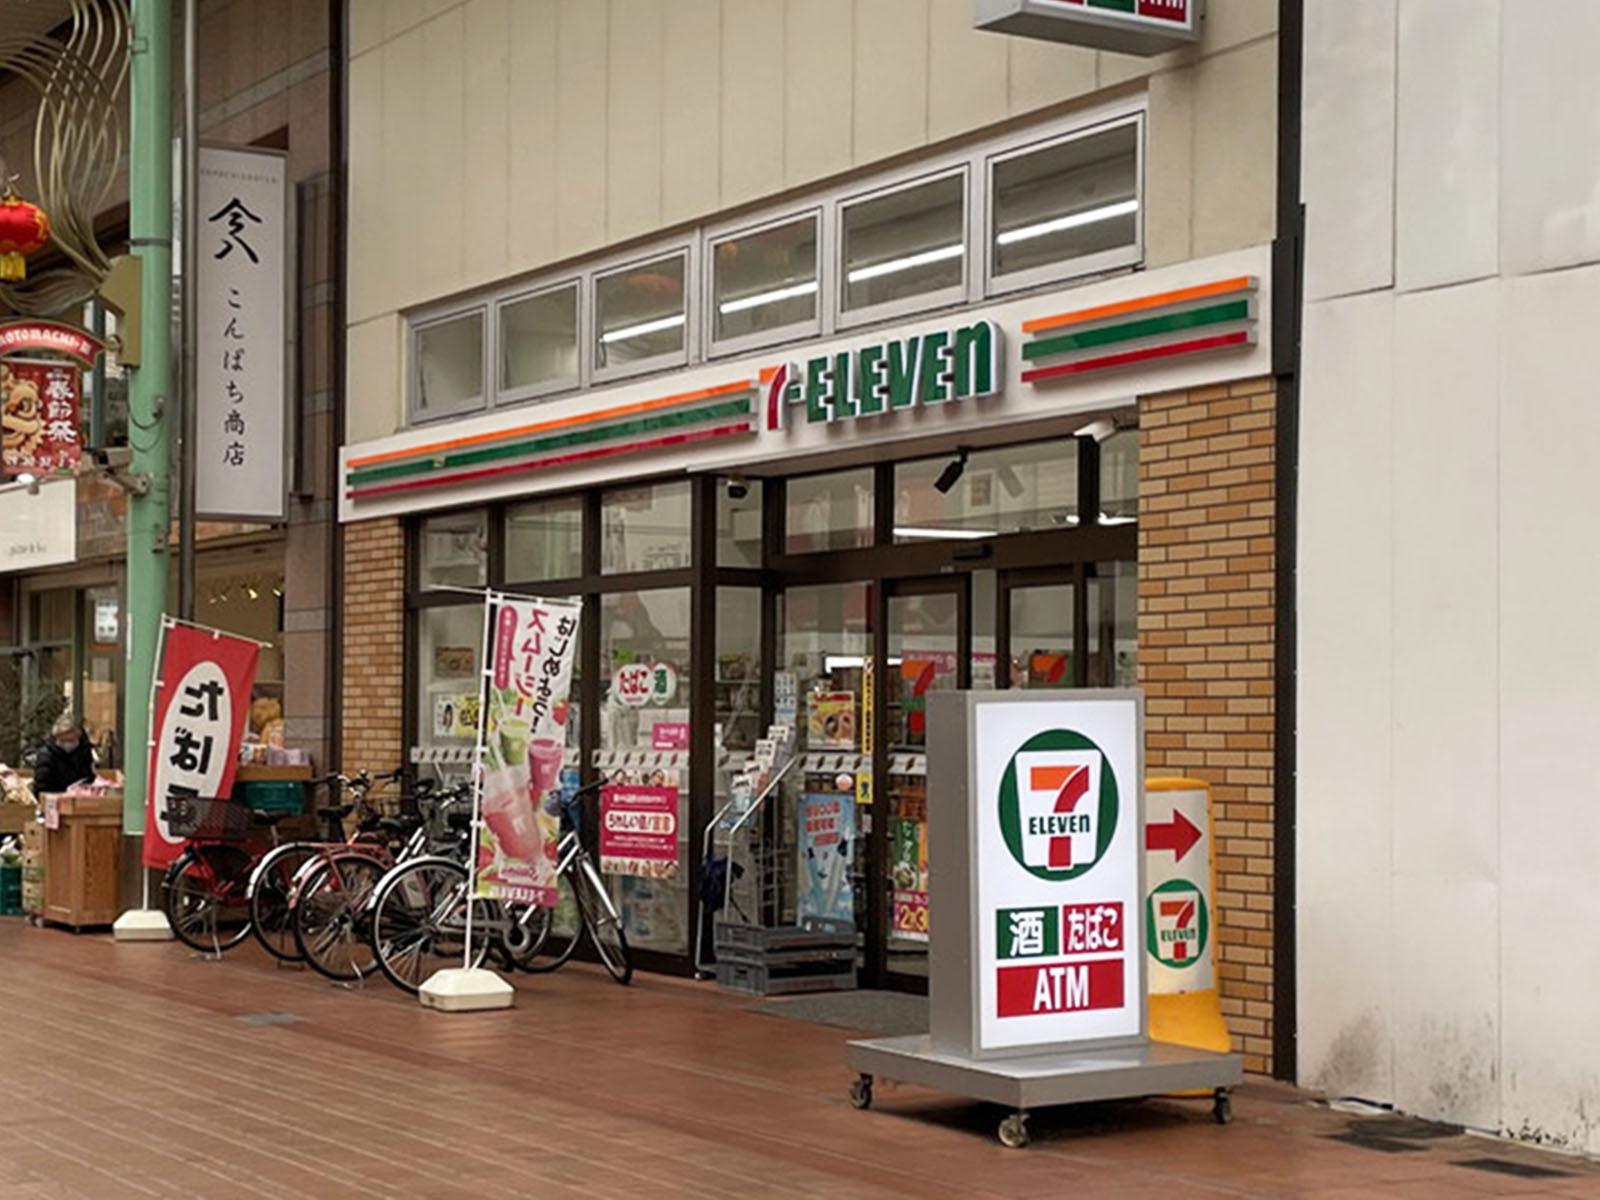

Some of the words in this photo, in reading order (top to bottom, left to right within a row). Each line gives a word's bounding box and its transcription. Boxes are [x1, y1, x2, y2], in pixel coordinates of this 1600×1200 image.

[619, 669, 649, 694] たばこ
[1009, 910, 1045, 957] 酒
[1067, 905, 1119, 952] たばこ
[1033, 965, 1090, 1012] ATM
